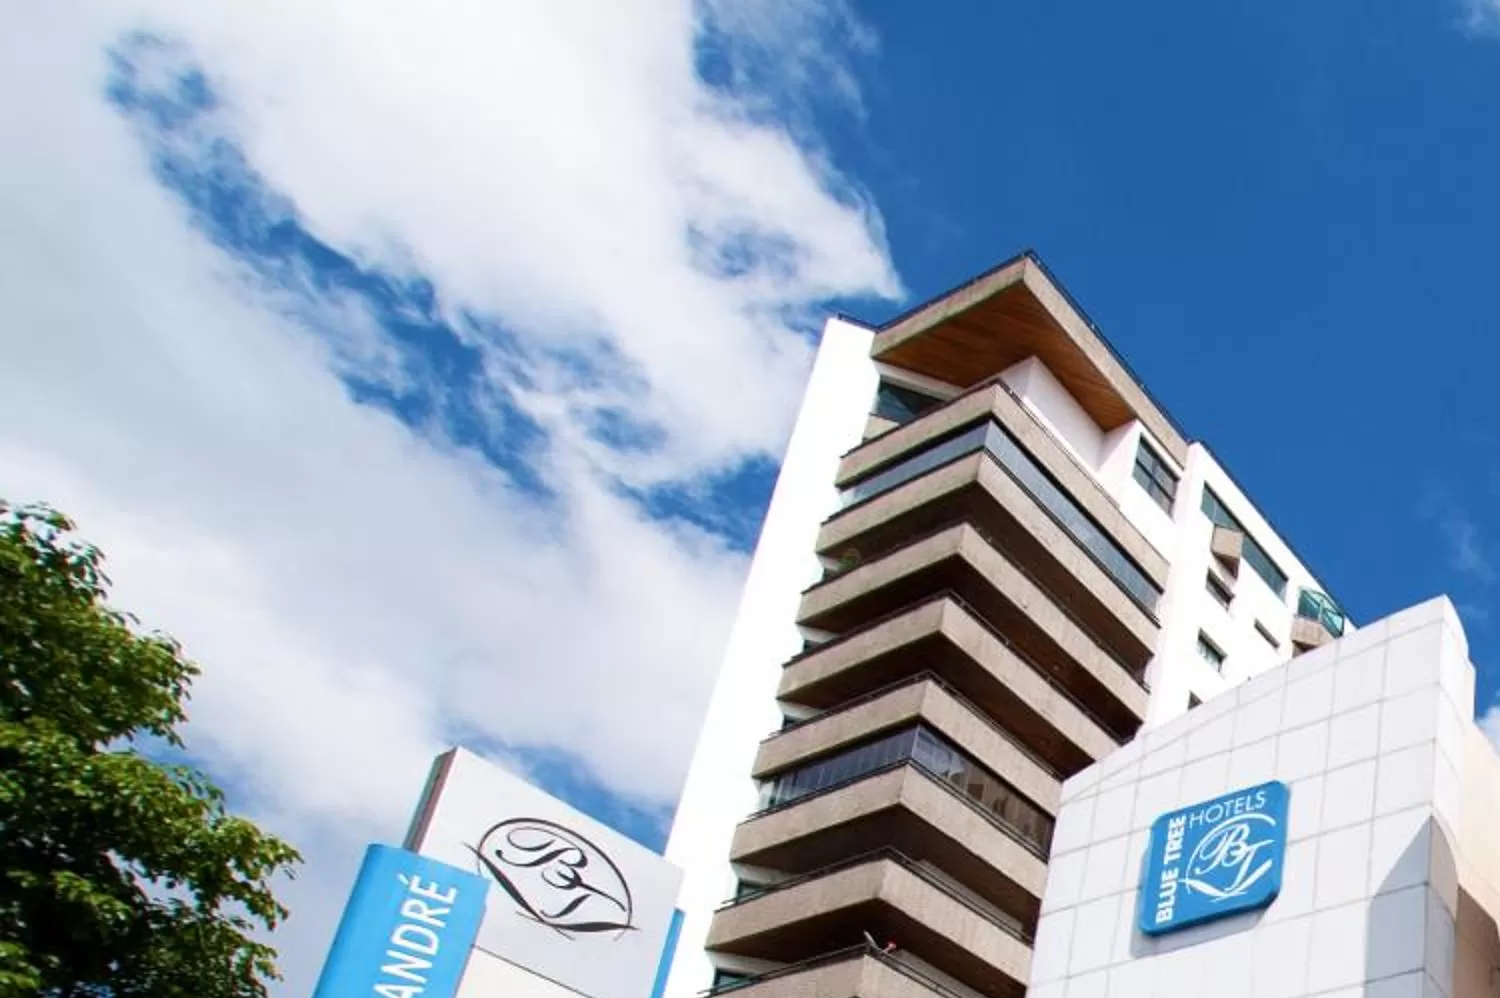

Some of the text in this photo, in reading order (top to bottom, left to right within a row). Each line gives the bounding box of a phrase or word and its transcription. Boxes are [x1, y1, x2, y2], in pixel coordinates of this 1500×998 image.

[1189, 790, 1267, 829] HOTELS
[1156, 814, 1186, 924] BLUE TREE
